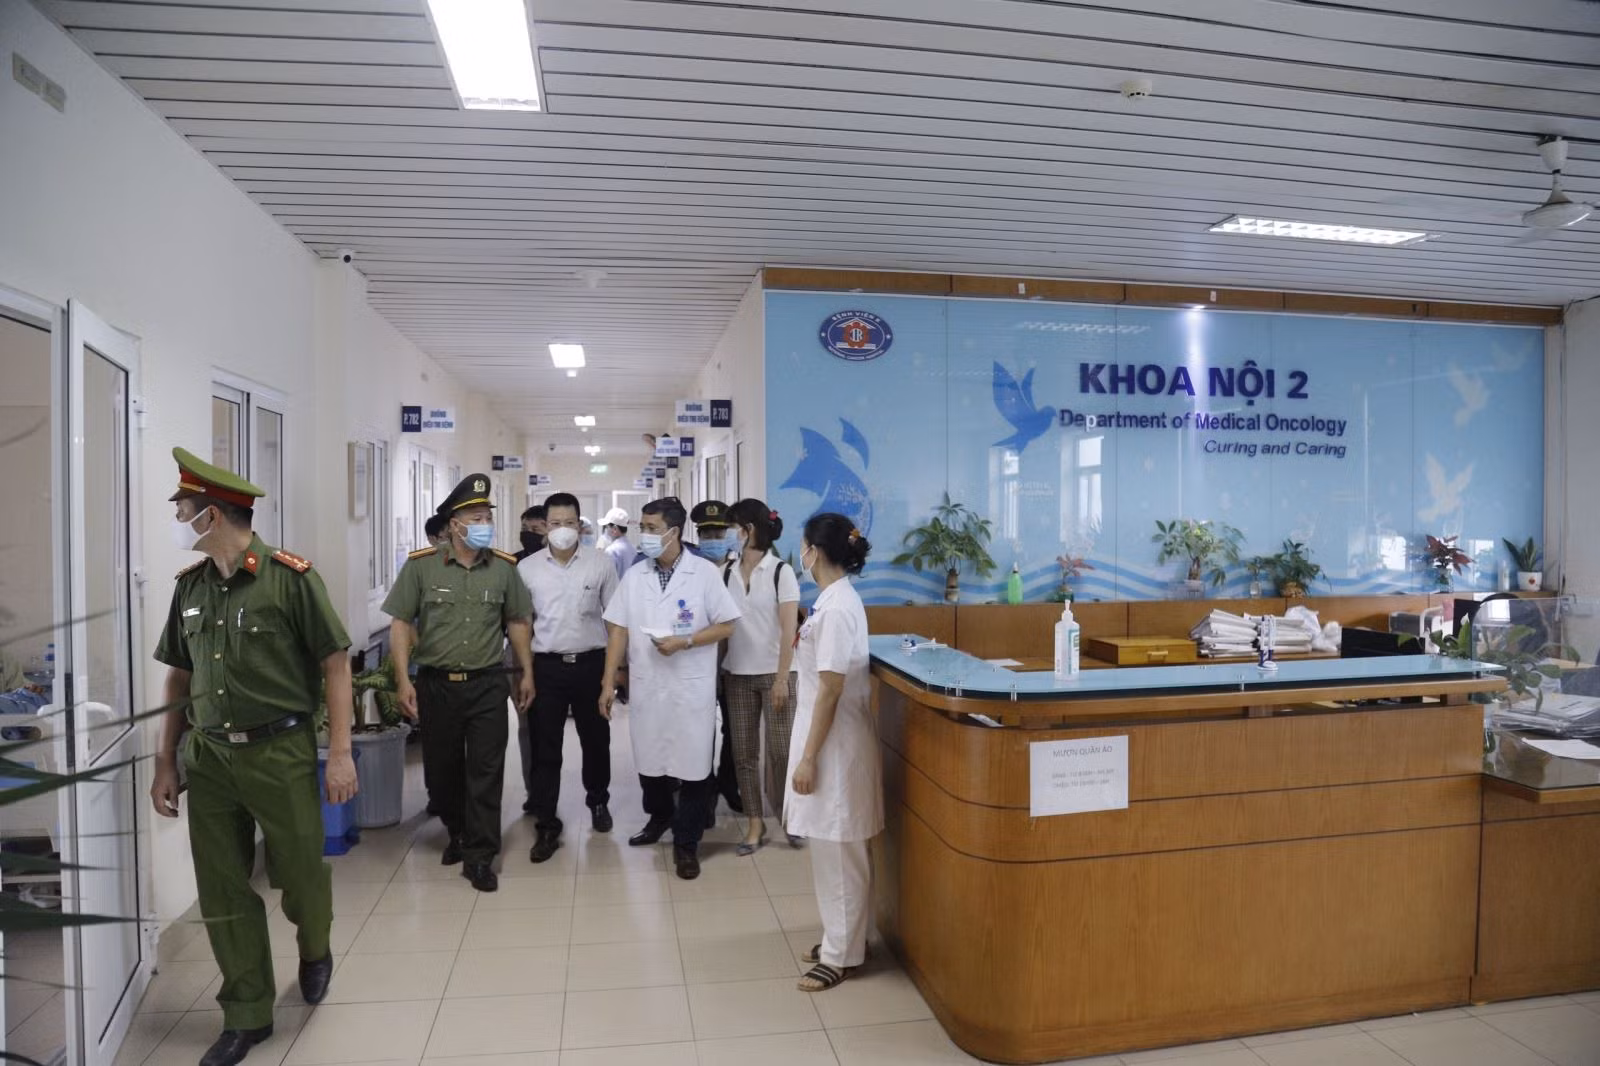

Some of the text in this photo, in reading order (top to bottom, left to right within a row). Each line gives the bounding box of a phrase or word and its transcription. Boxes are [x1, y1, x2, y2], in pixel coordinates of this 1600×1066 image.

[1079, 360, 1308, 406] KHOA NỘI 2
[1060, 409, 1347, 436] Department of Medical Oncology
[1204, 440, 1347, 458] Curing and Caring
